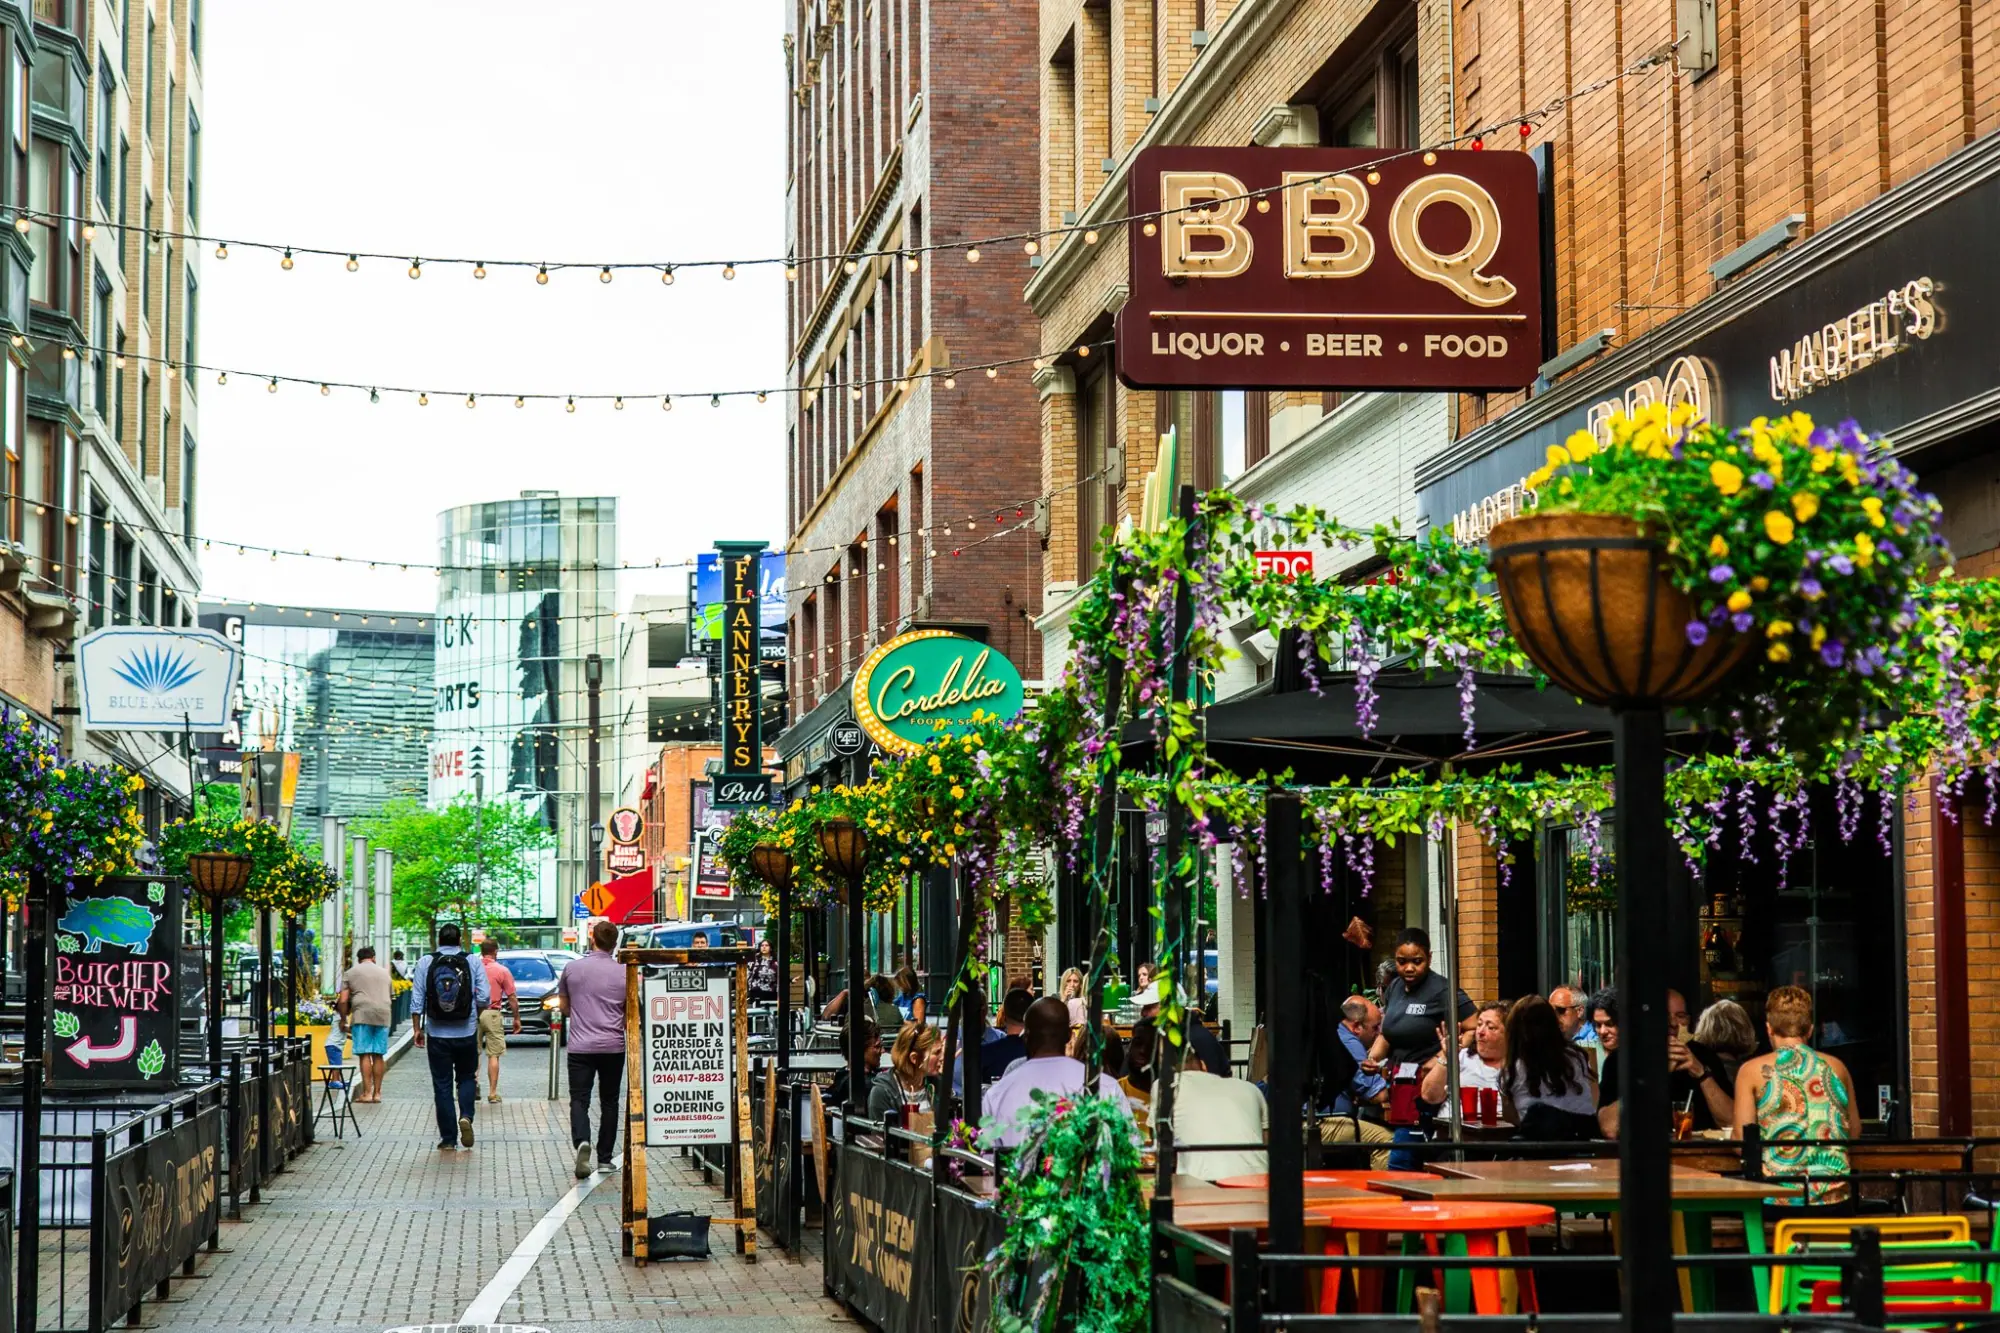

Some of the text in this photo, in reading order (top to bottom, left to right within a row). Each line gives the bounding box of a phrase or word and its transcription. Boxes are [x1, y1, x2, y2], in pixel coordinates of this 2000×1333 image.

[1160, 171, 1518, 307] BBQ
[1152, 332, 1509, 360] LIQUOR BEER FOOD
[1770, 276, 1936, 405] MABEL'S
[732, 561, 752, 767] FLANNERYS
[877, 648, 1006, 721] Cordelia
[109, 695, 204, 709] BLUE AGAVE
[718, 782, 767, 804] Pub
[56, 956, 171, 994] BUTCHER
[671, 978, 703, 990] BBQ
[70, 984, 159, 1011] BREWER
[651, 996, 723, 1020] OPEN
[652, 1022, 724, 1038] DINE IN
[652, 1038, 723, 1049] CURBSIDE &
[652, 1049, 724, 1060] CARRYOUT
[653, 1060, 724, 1071] AVAILABLE
[653, 1073, 724, 1084] (216) 417-8823
[664, 1090, 714, 1101] ONLINE
[653, 1102, 725, 1114] ORDERING
